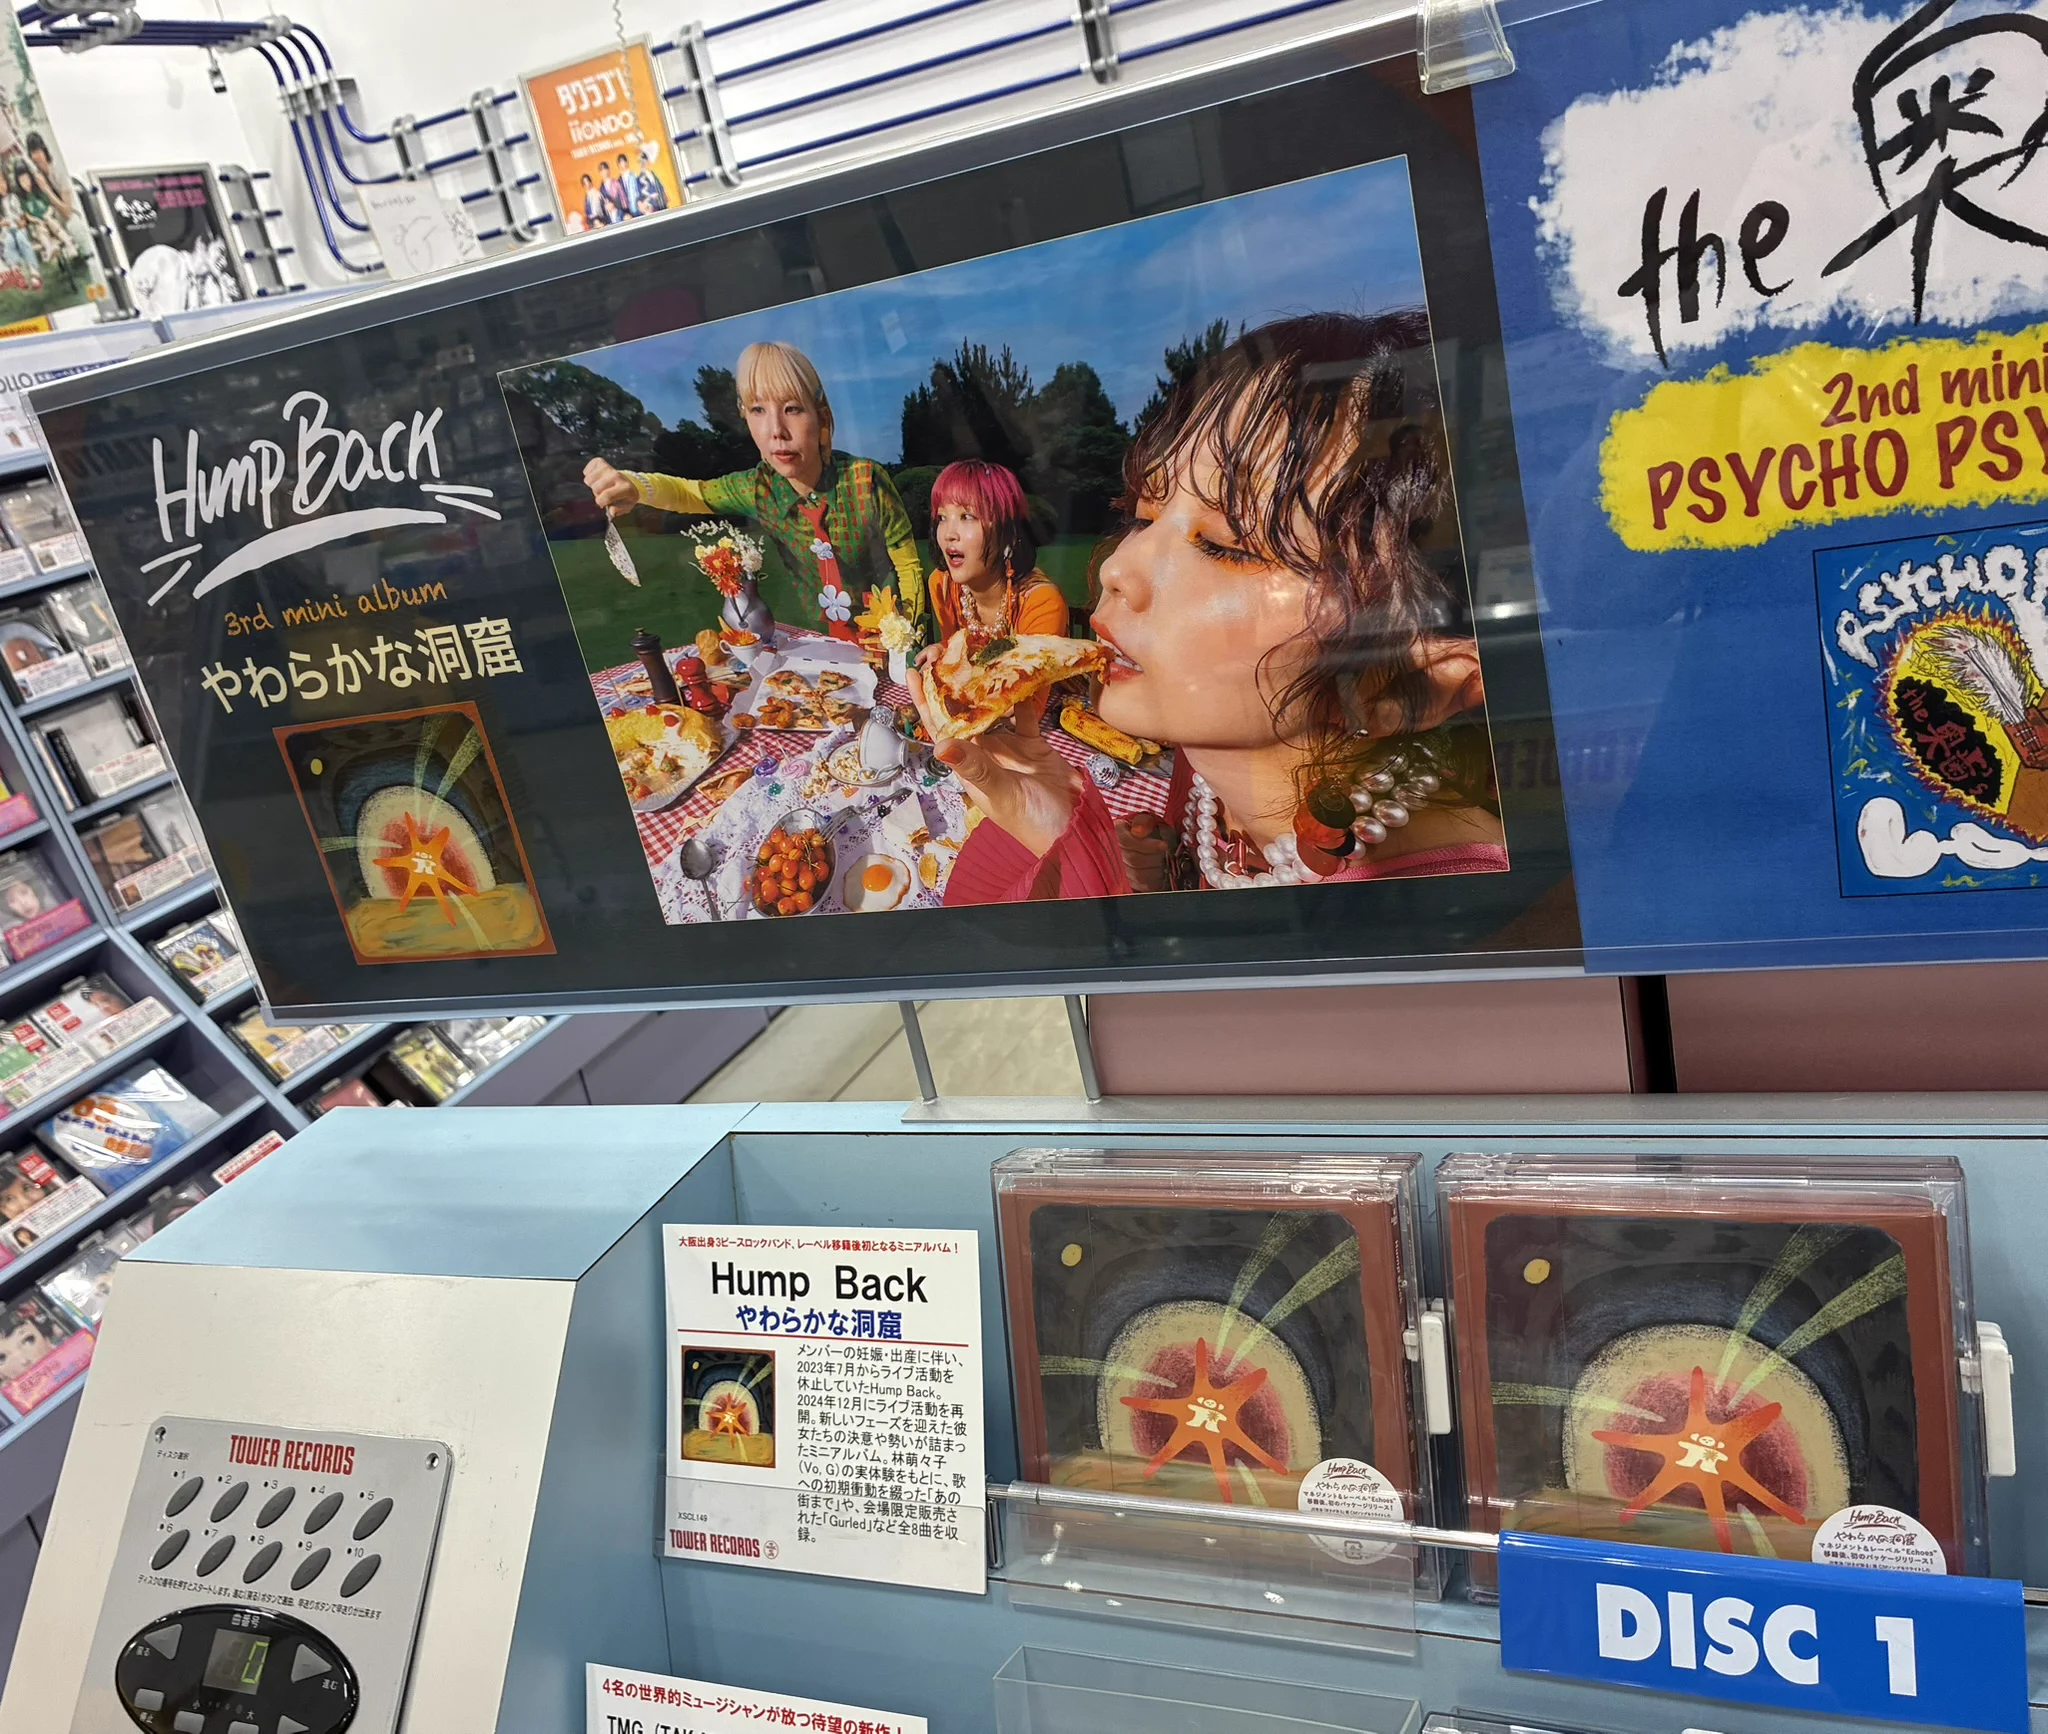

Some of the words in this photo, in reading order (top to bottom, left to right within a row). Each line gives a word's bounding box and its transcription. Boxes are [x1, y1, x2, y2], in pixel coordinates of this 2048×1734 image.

[1617, 186, 1794, 369] the
[1821, 363, 1921, 428] 2nd
[1941, 341, 2048, 408] mini
[153, 429, 286, 543] Hump
[1647, 427, 1908, 531] PSYCHO
[224, 603, 273, 637] 3rd
[282, 593, 348, 629] mini
[357, 578, 449, 615] album
[201, 616, 524, 714] やわらかな洞窟
[1903, 688, 1929, 722] the
[711, 1261, 810, 1301] Hump
[835, 1265, 928, 1303] Back
[735, 1305, 903, 1340] やわらかな洞窟
[797, 1361, 954, 1384] 2023年7月からライブ活動を
[797, 1394, 964, 1419] 2024年12月にライブ活動を再
[797, 1409, 967, 1436] 開。新しいフェーズを迎えた彼
[229, 1434, 281, 1467] TOWER
[283, 1440, 355, 1475] RECORDS
[797, 1427, 966, 1453] 女たちの決意や勢いが詰まっ
[797, 1444, 947, 1469] たミニアルバム。林萌々子
[798, 1478, 961, 1505] への初期衝動を綴った「あの
[669, 1529, 707, 1552] TOWER
[710, 1533, 760, 1558] RECORDS
[1596, 1582, 1820, 1685] DISC
[1875, 1615, 1918, 1697] 1
